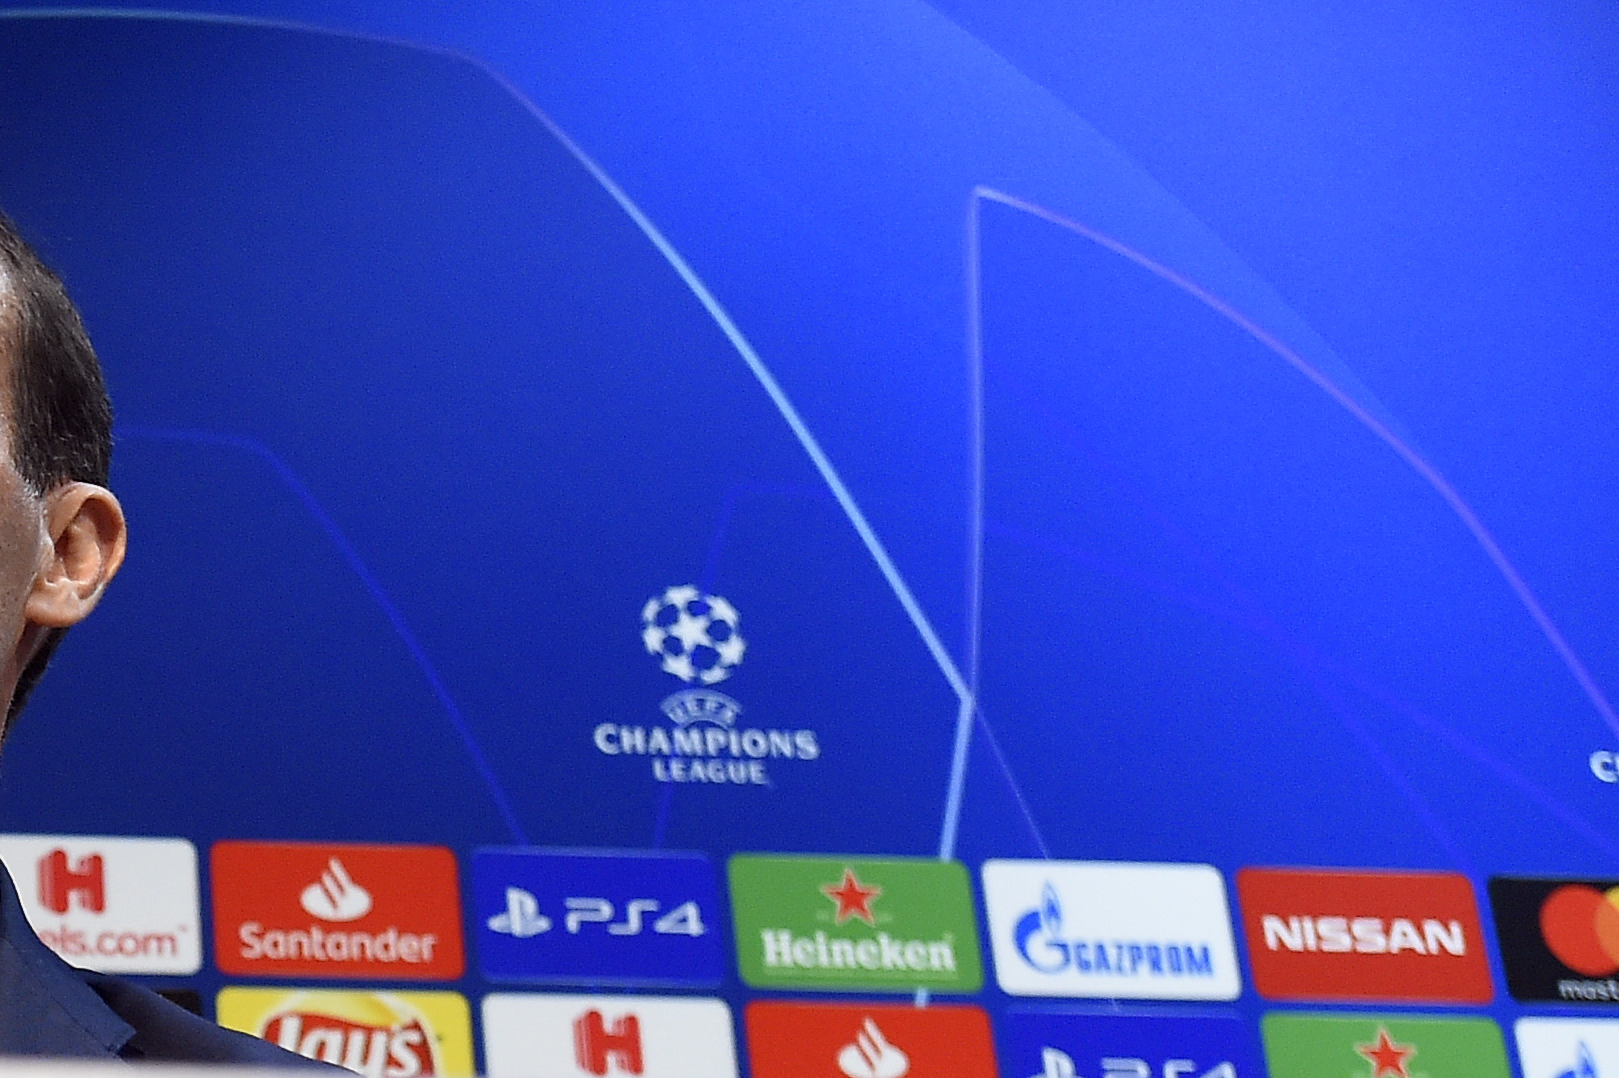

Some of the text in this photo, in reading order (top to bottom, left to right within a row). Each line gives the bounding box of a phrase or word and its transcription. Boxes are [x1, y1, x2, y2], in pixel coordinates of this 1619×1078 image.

[594, 723, 820, 761] CHAMPIONS
[652, 757, 769, 785] LEAGUE
[564, 896, 707, 938] PS4
[1261, 915, 1467, 956] NISSAN
[239, 921, 438, 963] Santander
[760, 927, 956, 972] Heineken
[1072, 938, 1215, 977] GAZPROM
[1558, 979, 1619, 1001] mast
